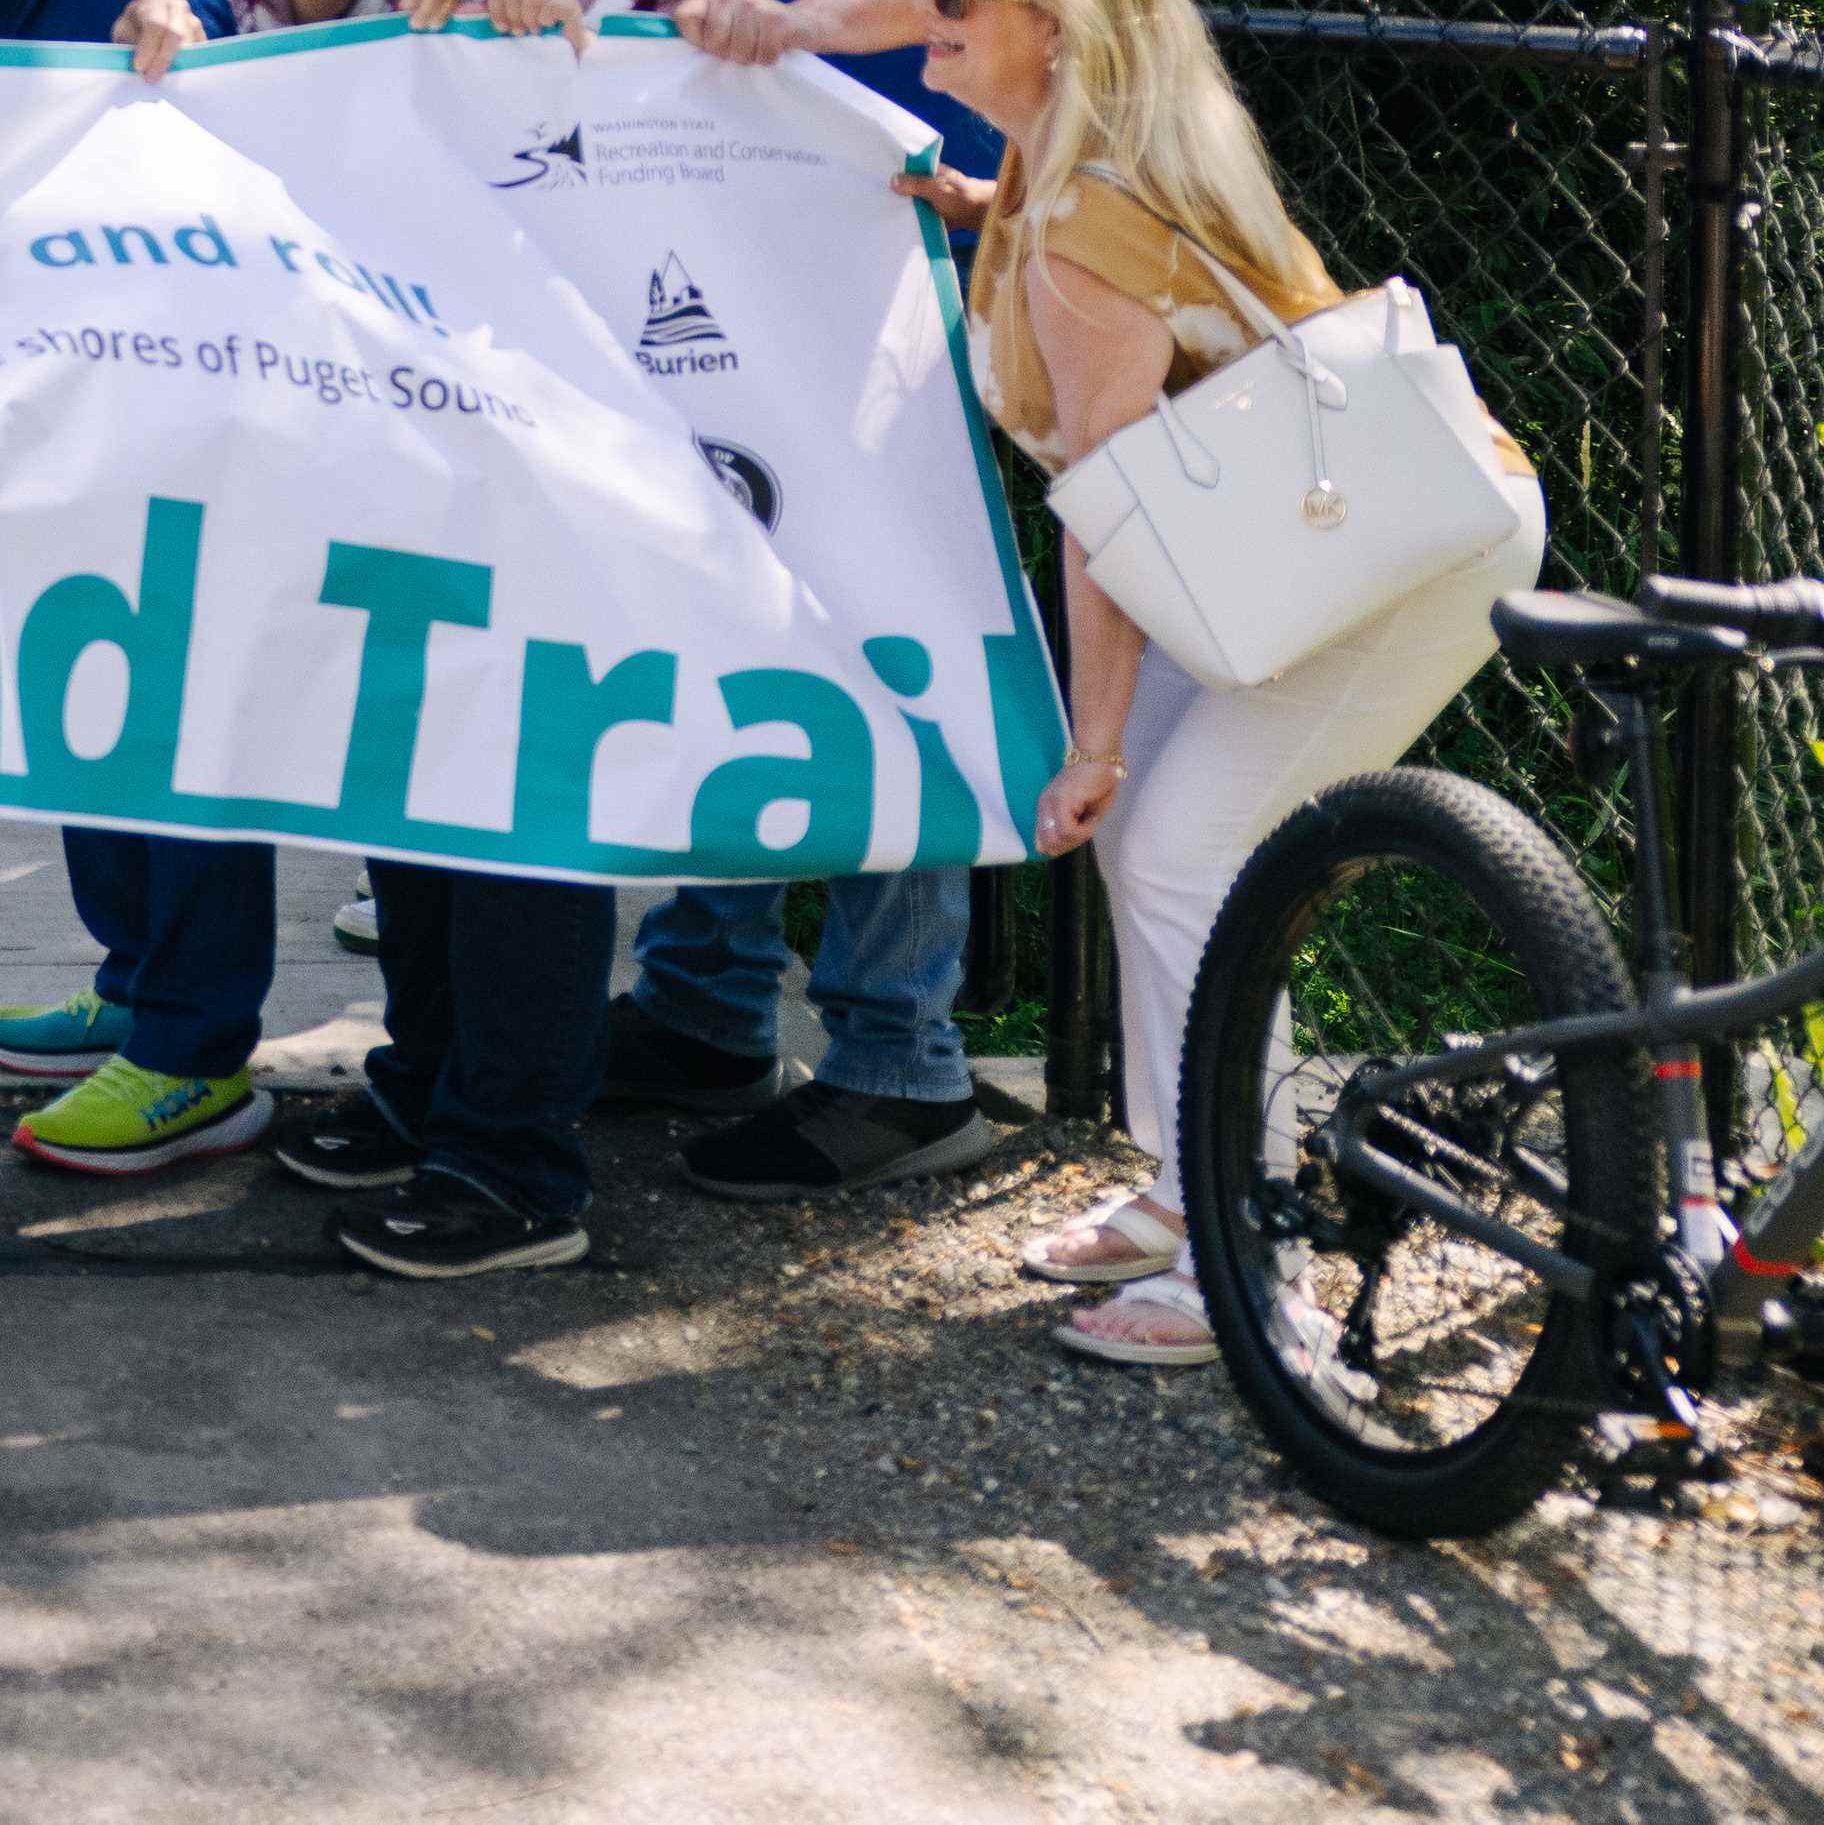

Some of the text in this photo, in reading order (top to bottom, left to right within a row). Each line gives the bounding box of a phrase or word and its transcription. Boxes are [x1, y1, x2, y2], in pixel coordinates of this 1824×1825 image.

[693, 141, 726, 161] and
[599, 162, 675, 187] Funding
[29, 214, 240, 269] and
[15, 326, 183, 370] shores
[197, 334, 241, 375] of
[254, 341, 381, 405] Puget
[635, 348, 739, 376] Burien
[317, 539, 1064, 870] Trail
